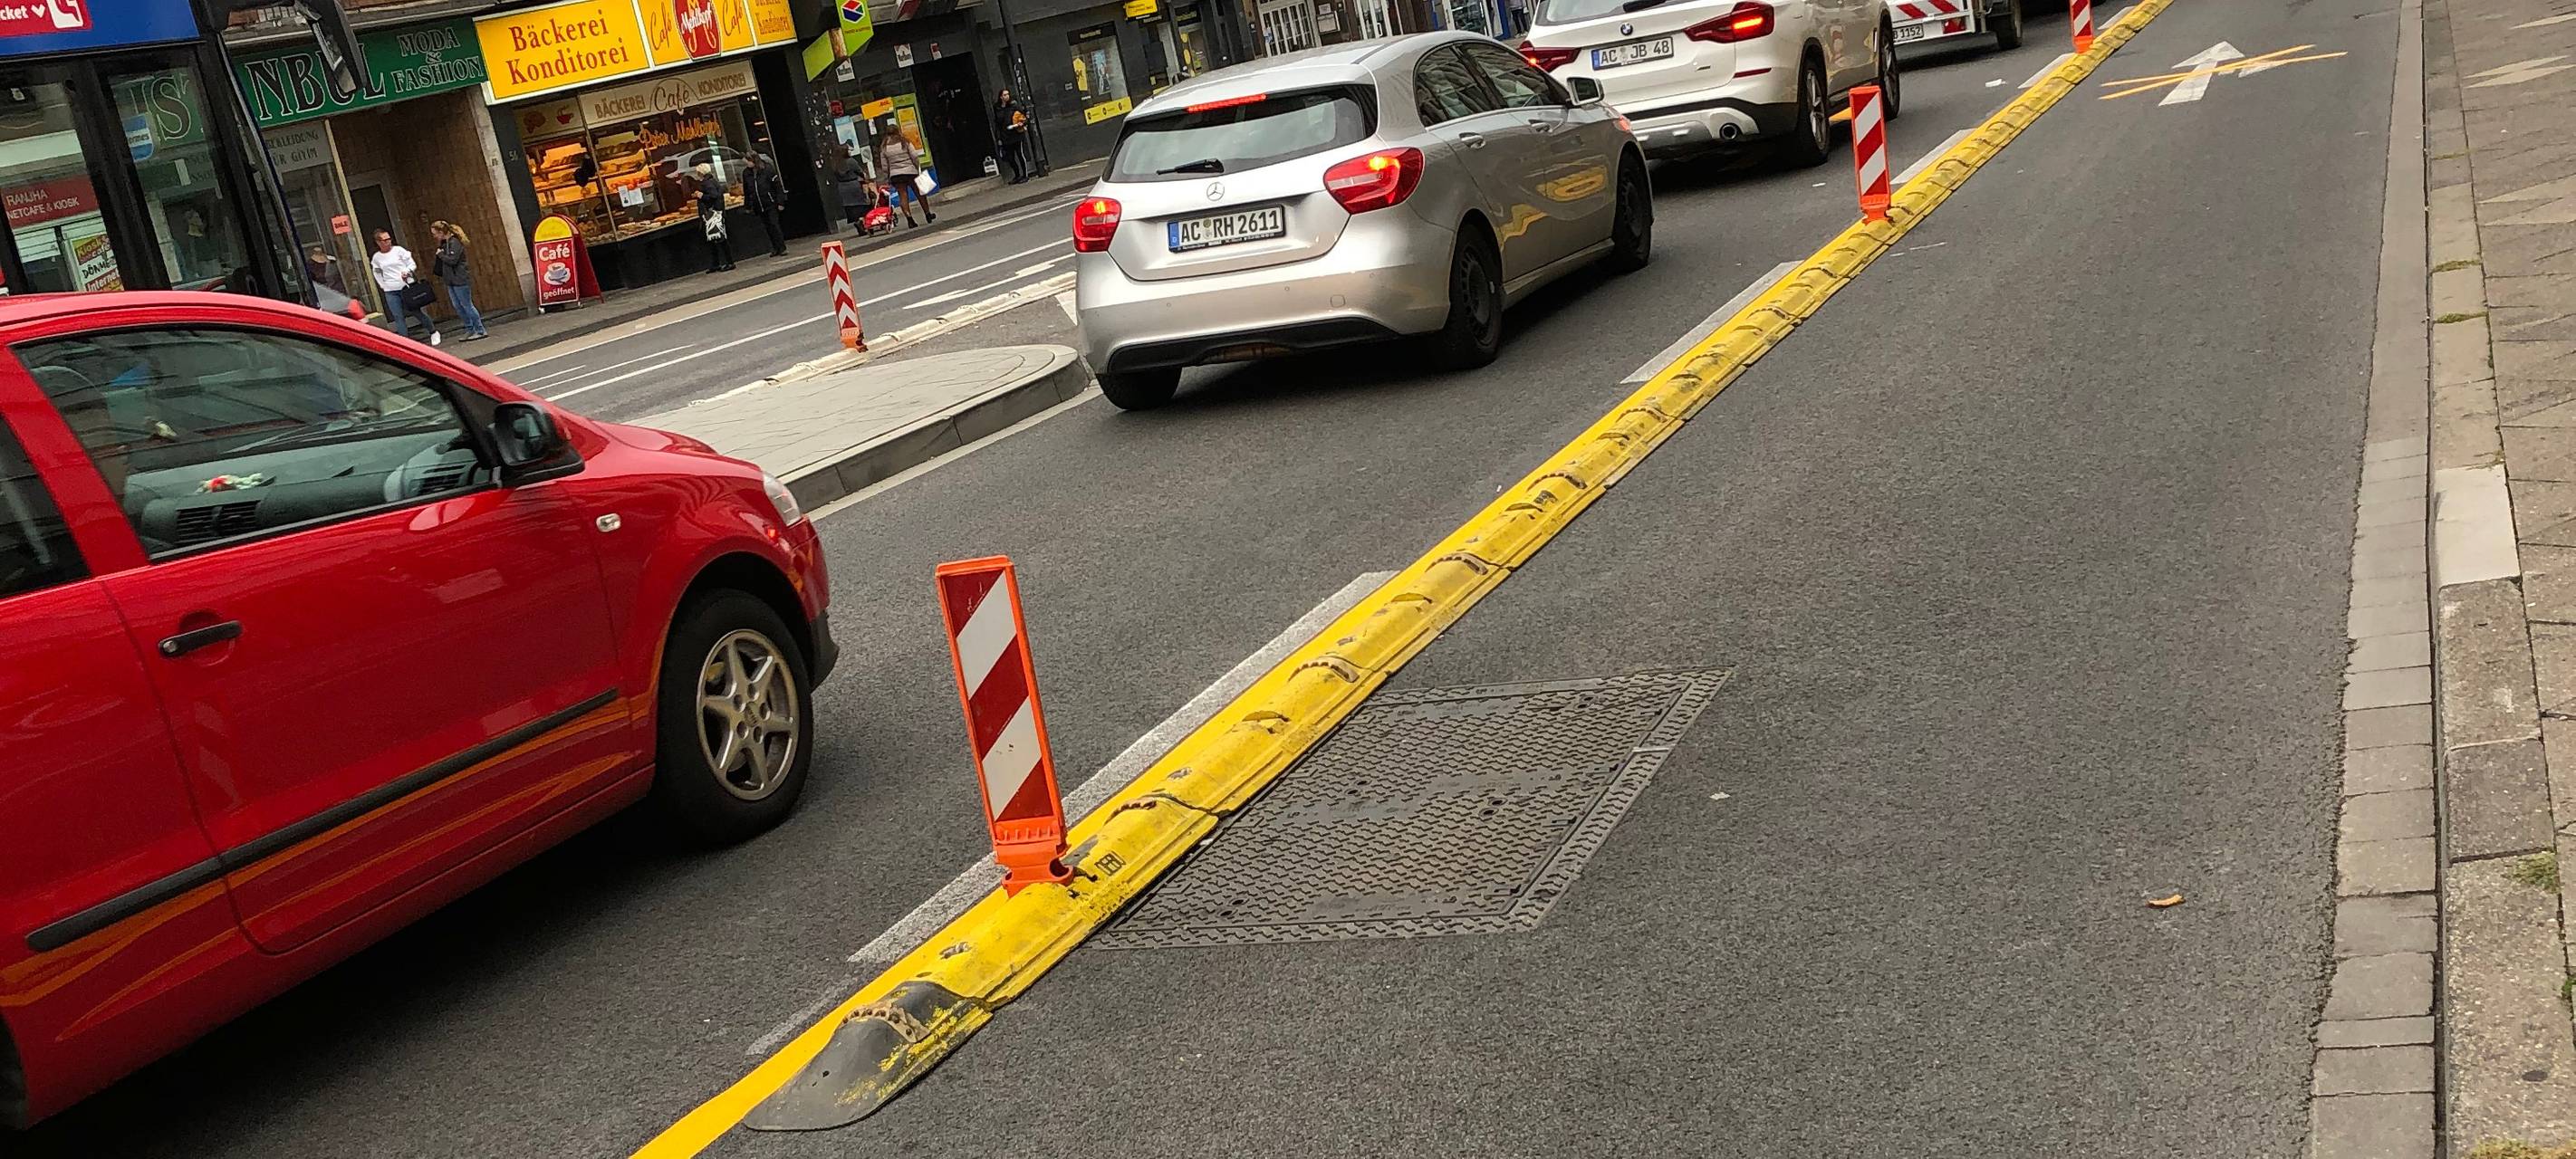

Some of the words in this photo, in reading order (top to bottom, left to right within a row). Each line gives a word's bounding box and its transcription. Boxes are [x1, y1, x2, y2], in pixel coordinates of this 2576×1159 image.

[508, 8, 610, 52] Bäckerei
[650, 1, 672, 51] Café
[1899, 26, 1921, 38] 1152
[397, 26, 461, 57] MODA
[1600, 49, 1618, 64] AC
[1630, 44, 1648, 59] JB
[1653, 40, 1669, 54] 48
[426, 51, 440, 63] &
[505, 36, 630, 85] Konditorei
[390, 56, 484, 93] FASHION
[697, 72, 746, 97] KONDITOREI
[594, 94, 647, 119] BÄCKEREI
[654, 82, 691, 115] Café
[6, 204, 45, 219] NETCAFE
[54, 196, 80, 210] KIOSK
[1181, 221, 1201, 243] AC
[1214, 216, 1235, 238] RH
[1237, 210, 1279, 235] 2611
[538, 243, 571, 261] Café
[543, 286, 574, 300] geöffnet
